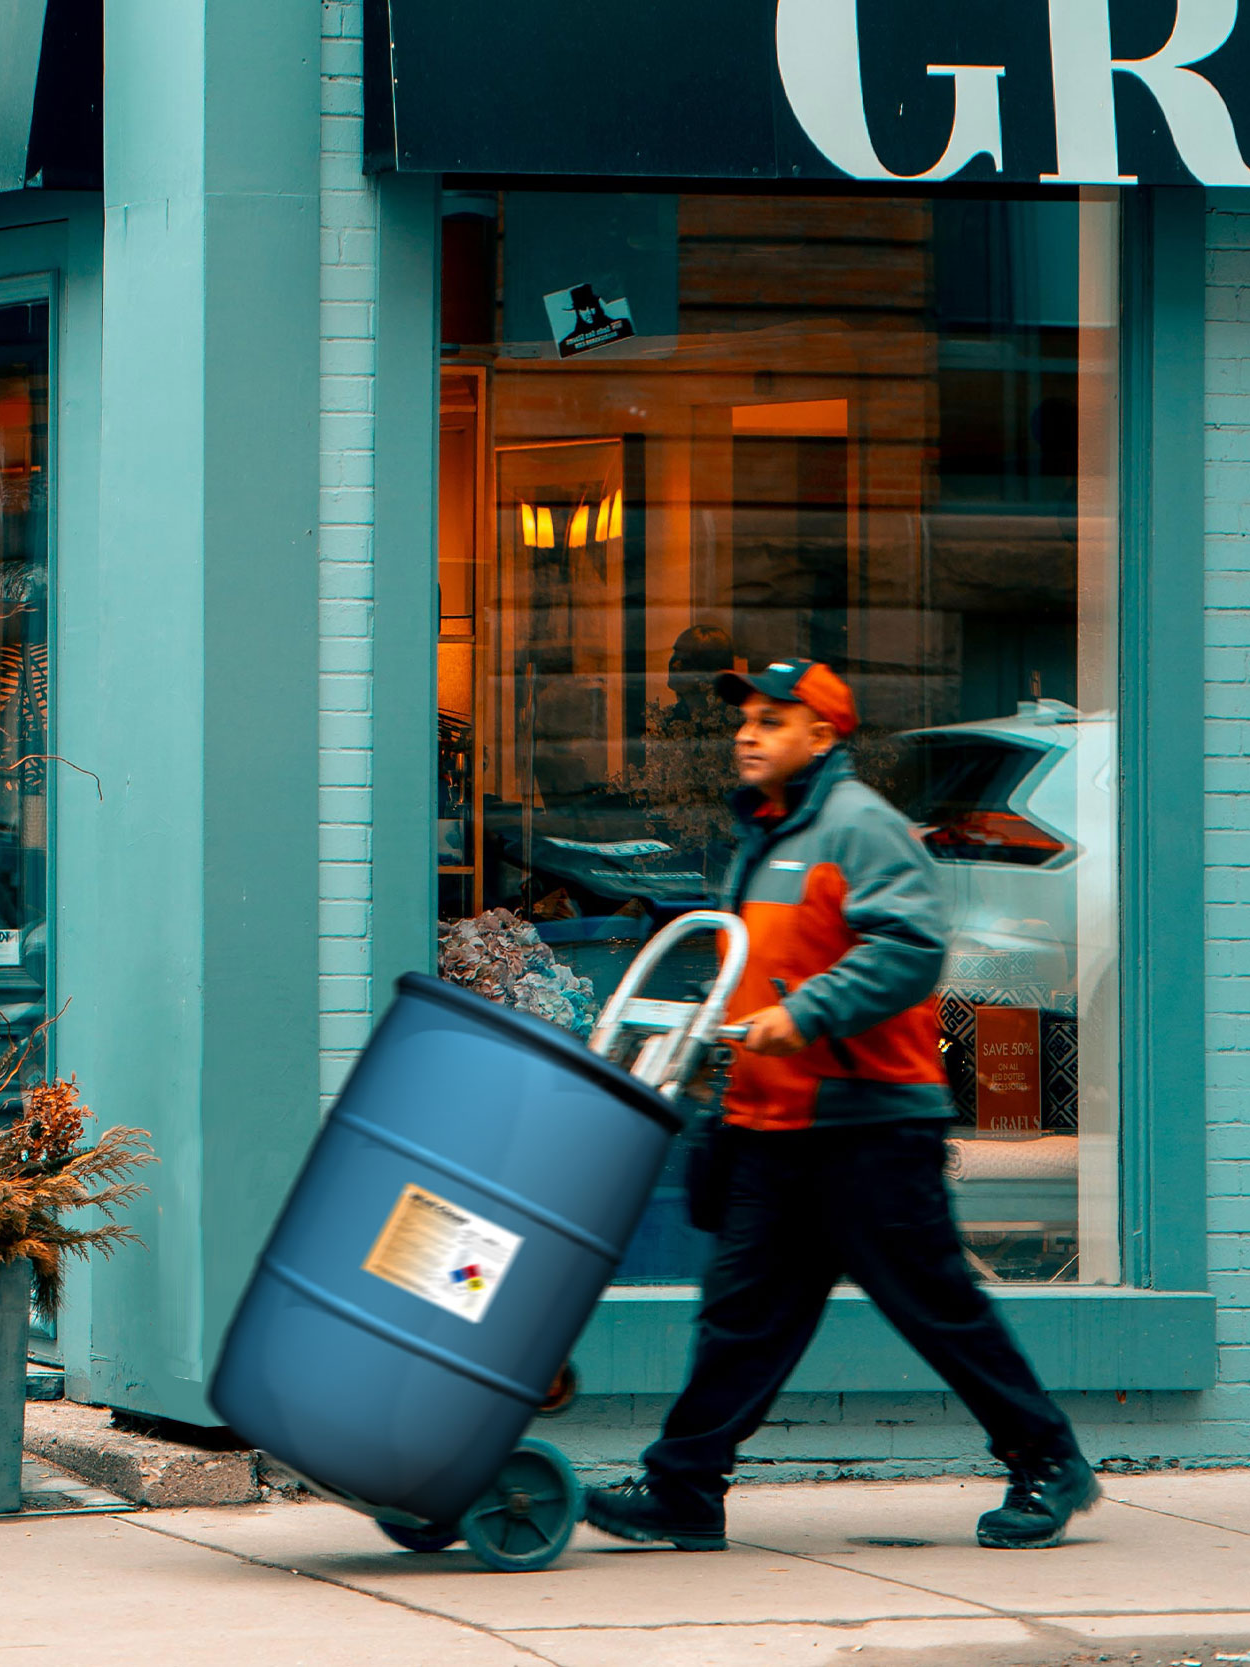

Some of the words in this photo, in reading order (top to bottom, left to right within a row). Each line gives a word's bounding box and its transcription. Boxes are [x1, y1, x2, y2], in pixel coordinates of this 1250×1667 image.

[982, 1042, 1009, 1056] SAVE
[1011, 1042, 1034, 1056] 50%
[998, 1063, 1008, 1071] ON
[1009, 1063, 1019, 1071] ALL
[1003, 1072, 1026, 1081] DOTTED
